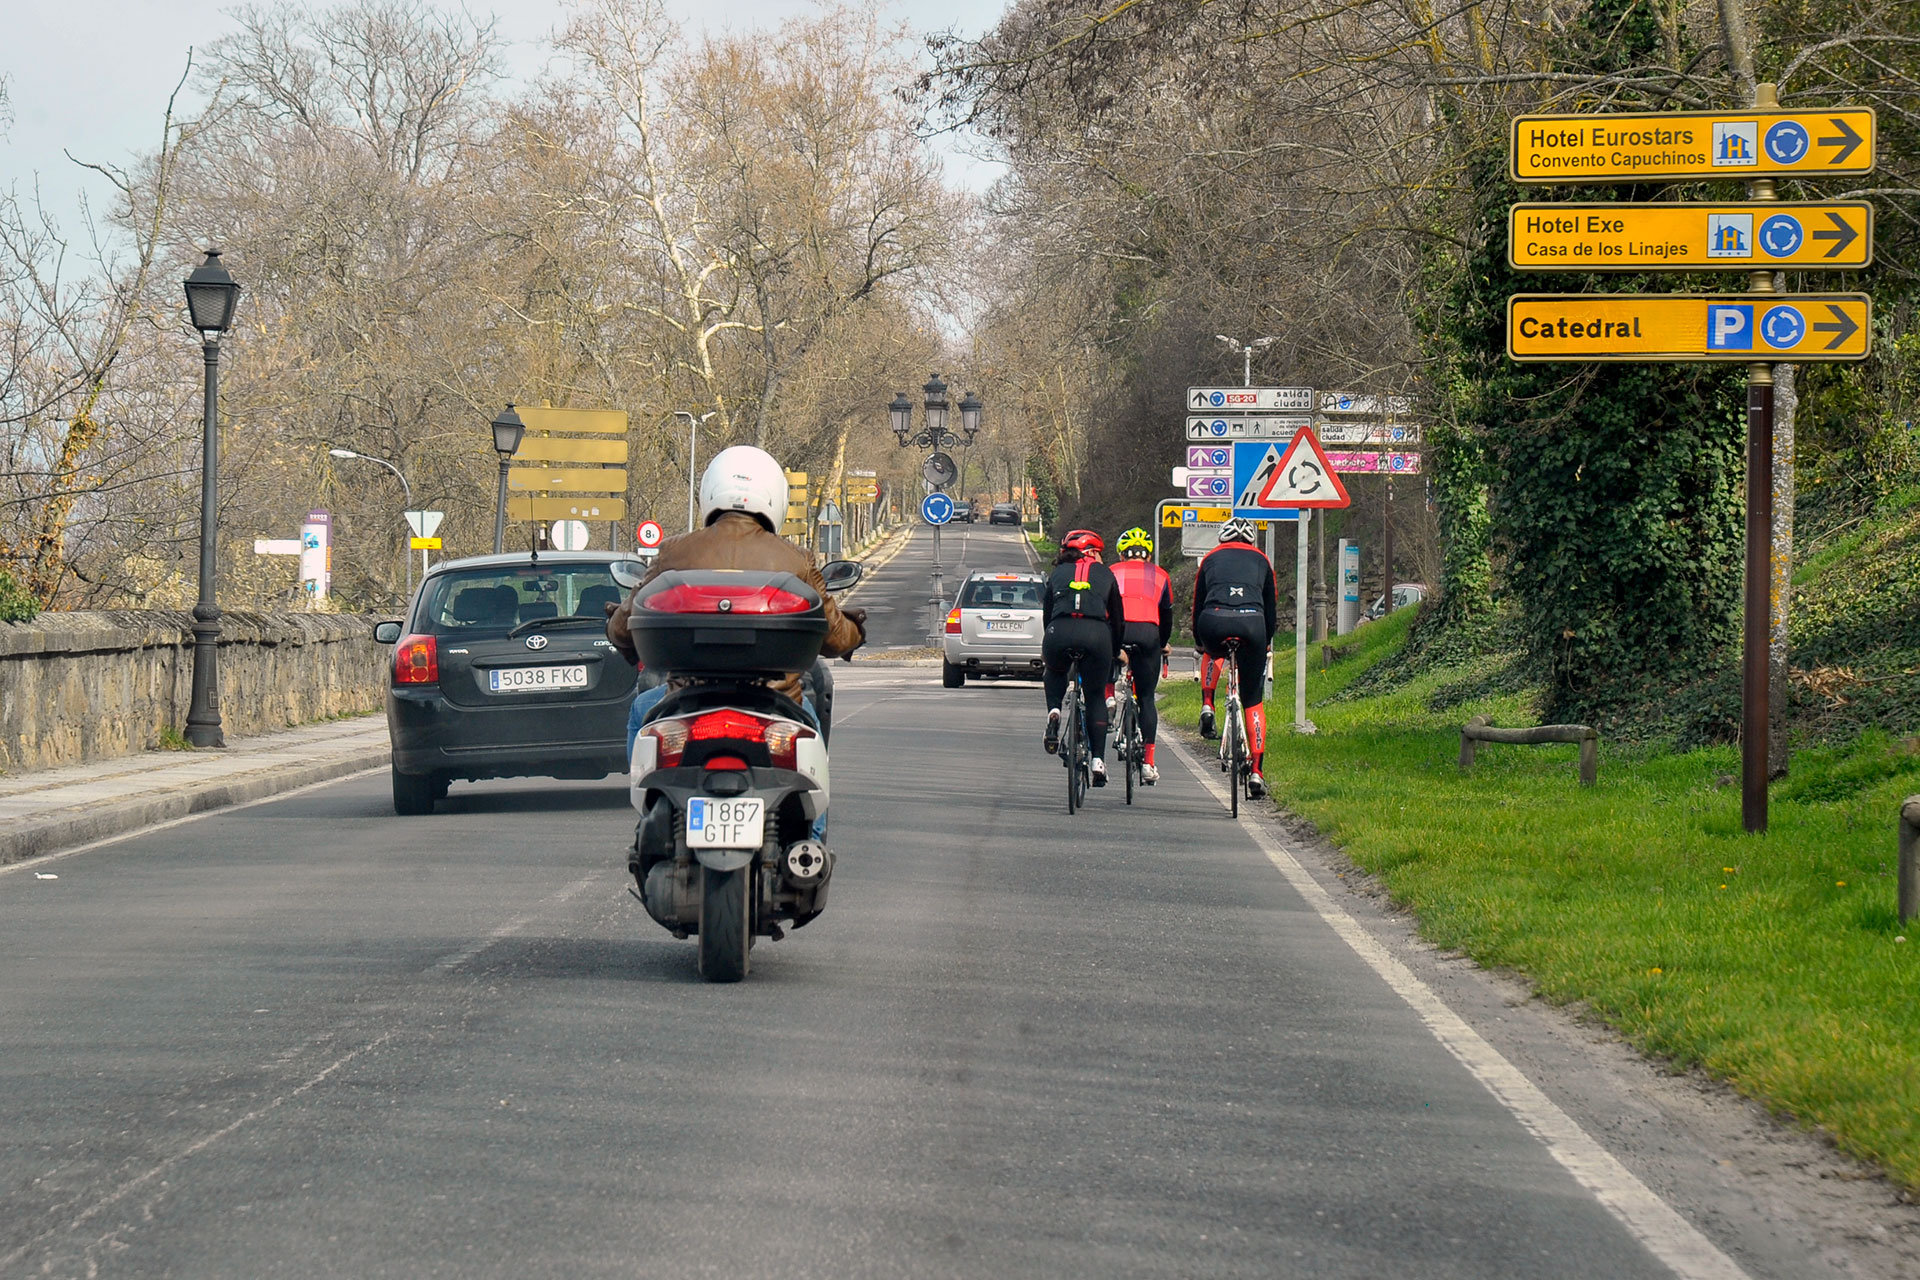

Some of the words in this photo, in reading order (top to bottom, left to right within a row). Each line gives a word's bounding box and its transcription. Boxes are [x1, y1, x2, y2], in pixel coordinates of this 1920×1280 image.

[1530, 129, 1583, 148] Hotel
[1592, 127, 1694, 147] Eurostars
[1530, 152, 1606, 168] Convento
[1611, 150, 1706, 170] Capuchinos
[1527, 216, 1579, 233] Hotel
[1587, 216, 1625, 233] Exe
[1526, 242, 1568, 257] Casa
[1573, 241, 1593, 257] de
[1598, 241, 1623, 256] los
[1629, 241, 1688, 259] Linajes
[1519, 316, 1642, 340] Catedral
[1714, 309, 1745, 345] P
[1228, 395, 1255, 403] SG-20
[1276, 390, 1309, 398] salida
[1321, 425, 1343, 433] salida
[1184, 511, 1195, 521] P
[502, 670, 545, 686] 5038
[551, 668, 584, 684] FKC
[708, 802, 760, 822] 1867
[704, 823, 745, 843] GTF
